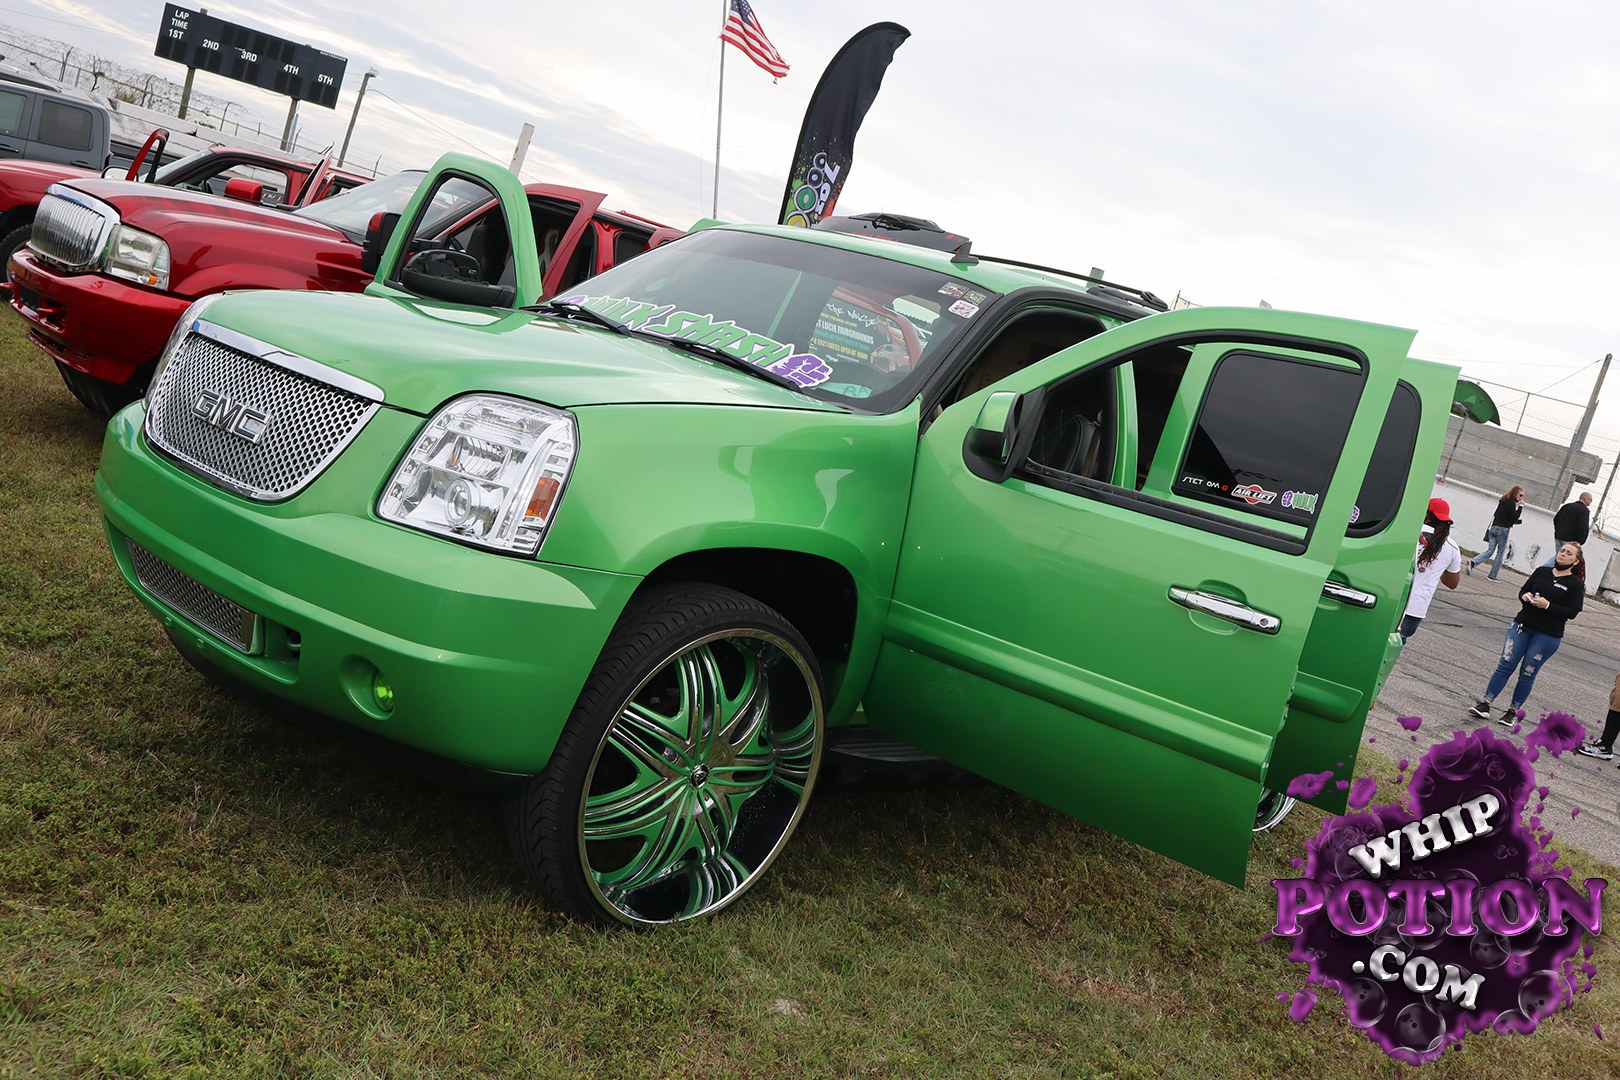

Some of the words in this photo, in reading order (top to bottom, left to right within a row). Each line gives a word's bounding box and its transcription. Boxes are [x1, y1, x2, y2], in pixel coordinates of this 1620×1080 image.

[174, 9, 190, 20] LAP
[171, 18, 188, 30] TIME
[168, 28, 184, 41] 1ST
[202, 38, 220, 51] 2ND
[240, 50, 258, 63] 3RD
[283, 63, 299, 75] 4TH
[317, 73, 334, 86] 5TH
[641, 311, 796, 370] SMASH
[191, 389, 271, 444] GMC
[1235, 487, 1252, 497] AIR
[1252, 491, 1273, 501] LIFT
